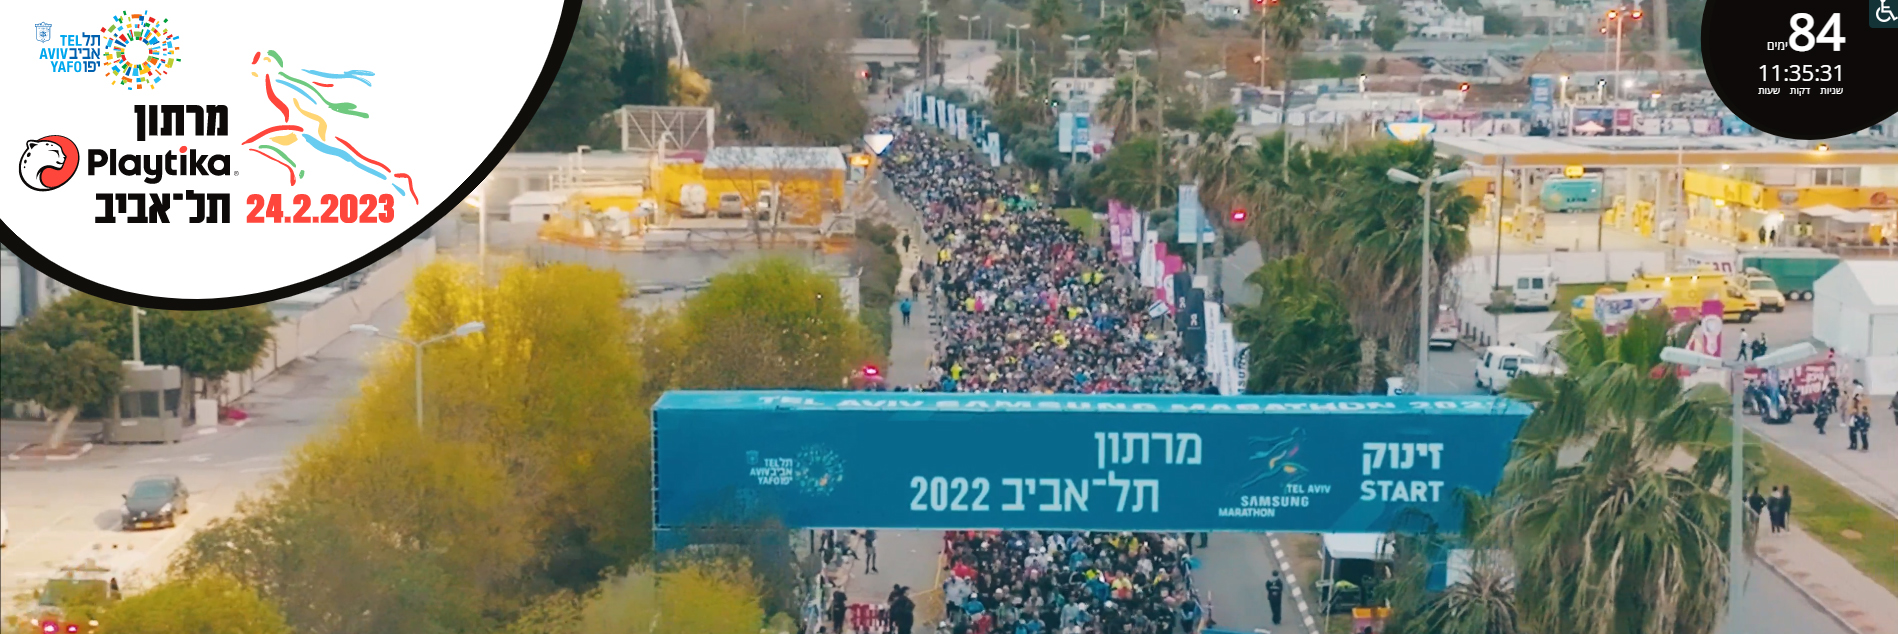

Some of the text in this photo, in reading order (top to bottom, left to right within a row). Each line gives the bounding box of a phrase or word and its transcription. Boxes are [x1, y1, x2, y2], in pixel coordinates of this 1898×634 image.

[759, 396, 825, 407] TEL
[836, 399, 924, 408] AVIV
[1095, 432, 1202, 469] מרתון
[764, 459, 779, 467] TEL
[1363, 443, 1444, 475] זינוק
[750, 468, 769, 476] AVIV
[758, 477, 780, 485] YAFO
[910, 476, 990, 511] 2022
[1286, 484, 1331, 494] TEL AVIV
[1360, 480, 1445, 502] START
[1240, 496, 1309, 507] SAMSUNG
[1218, 508, 1275, 518] MARATHON
